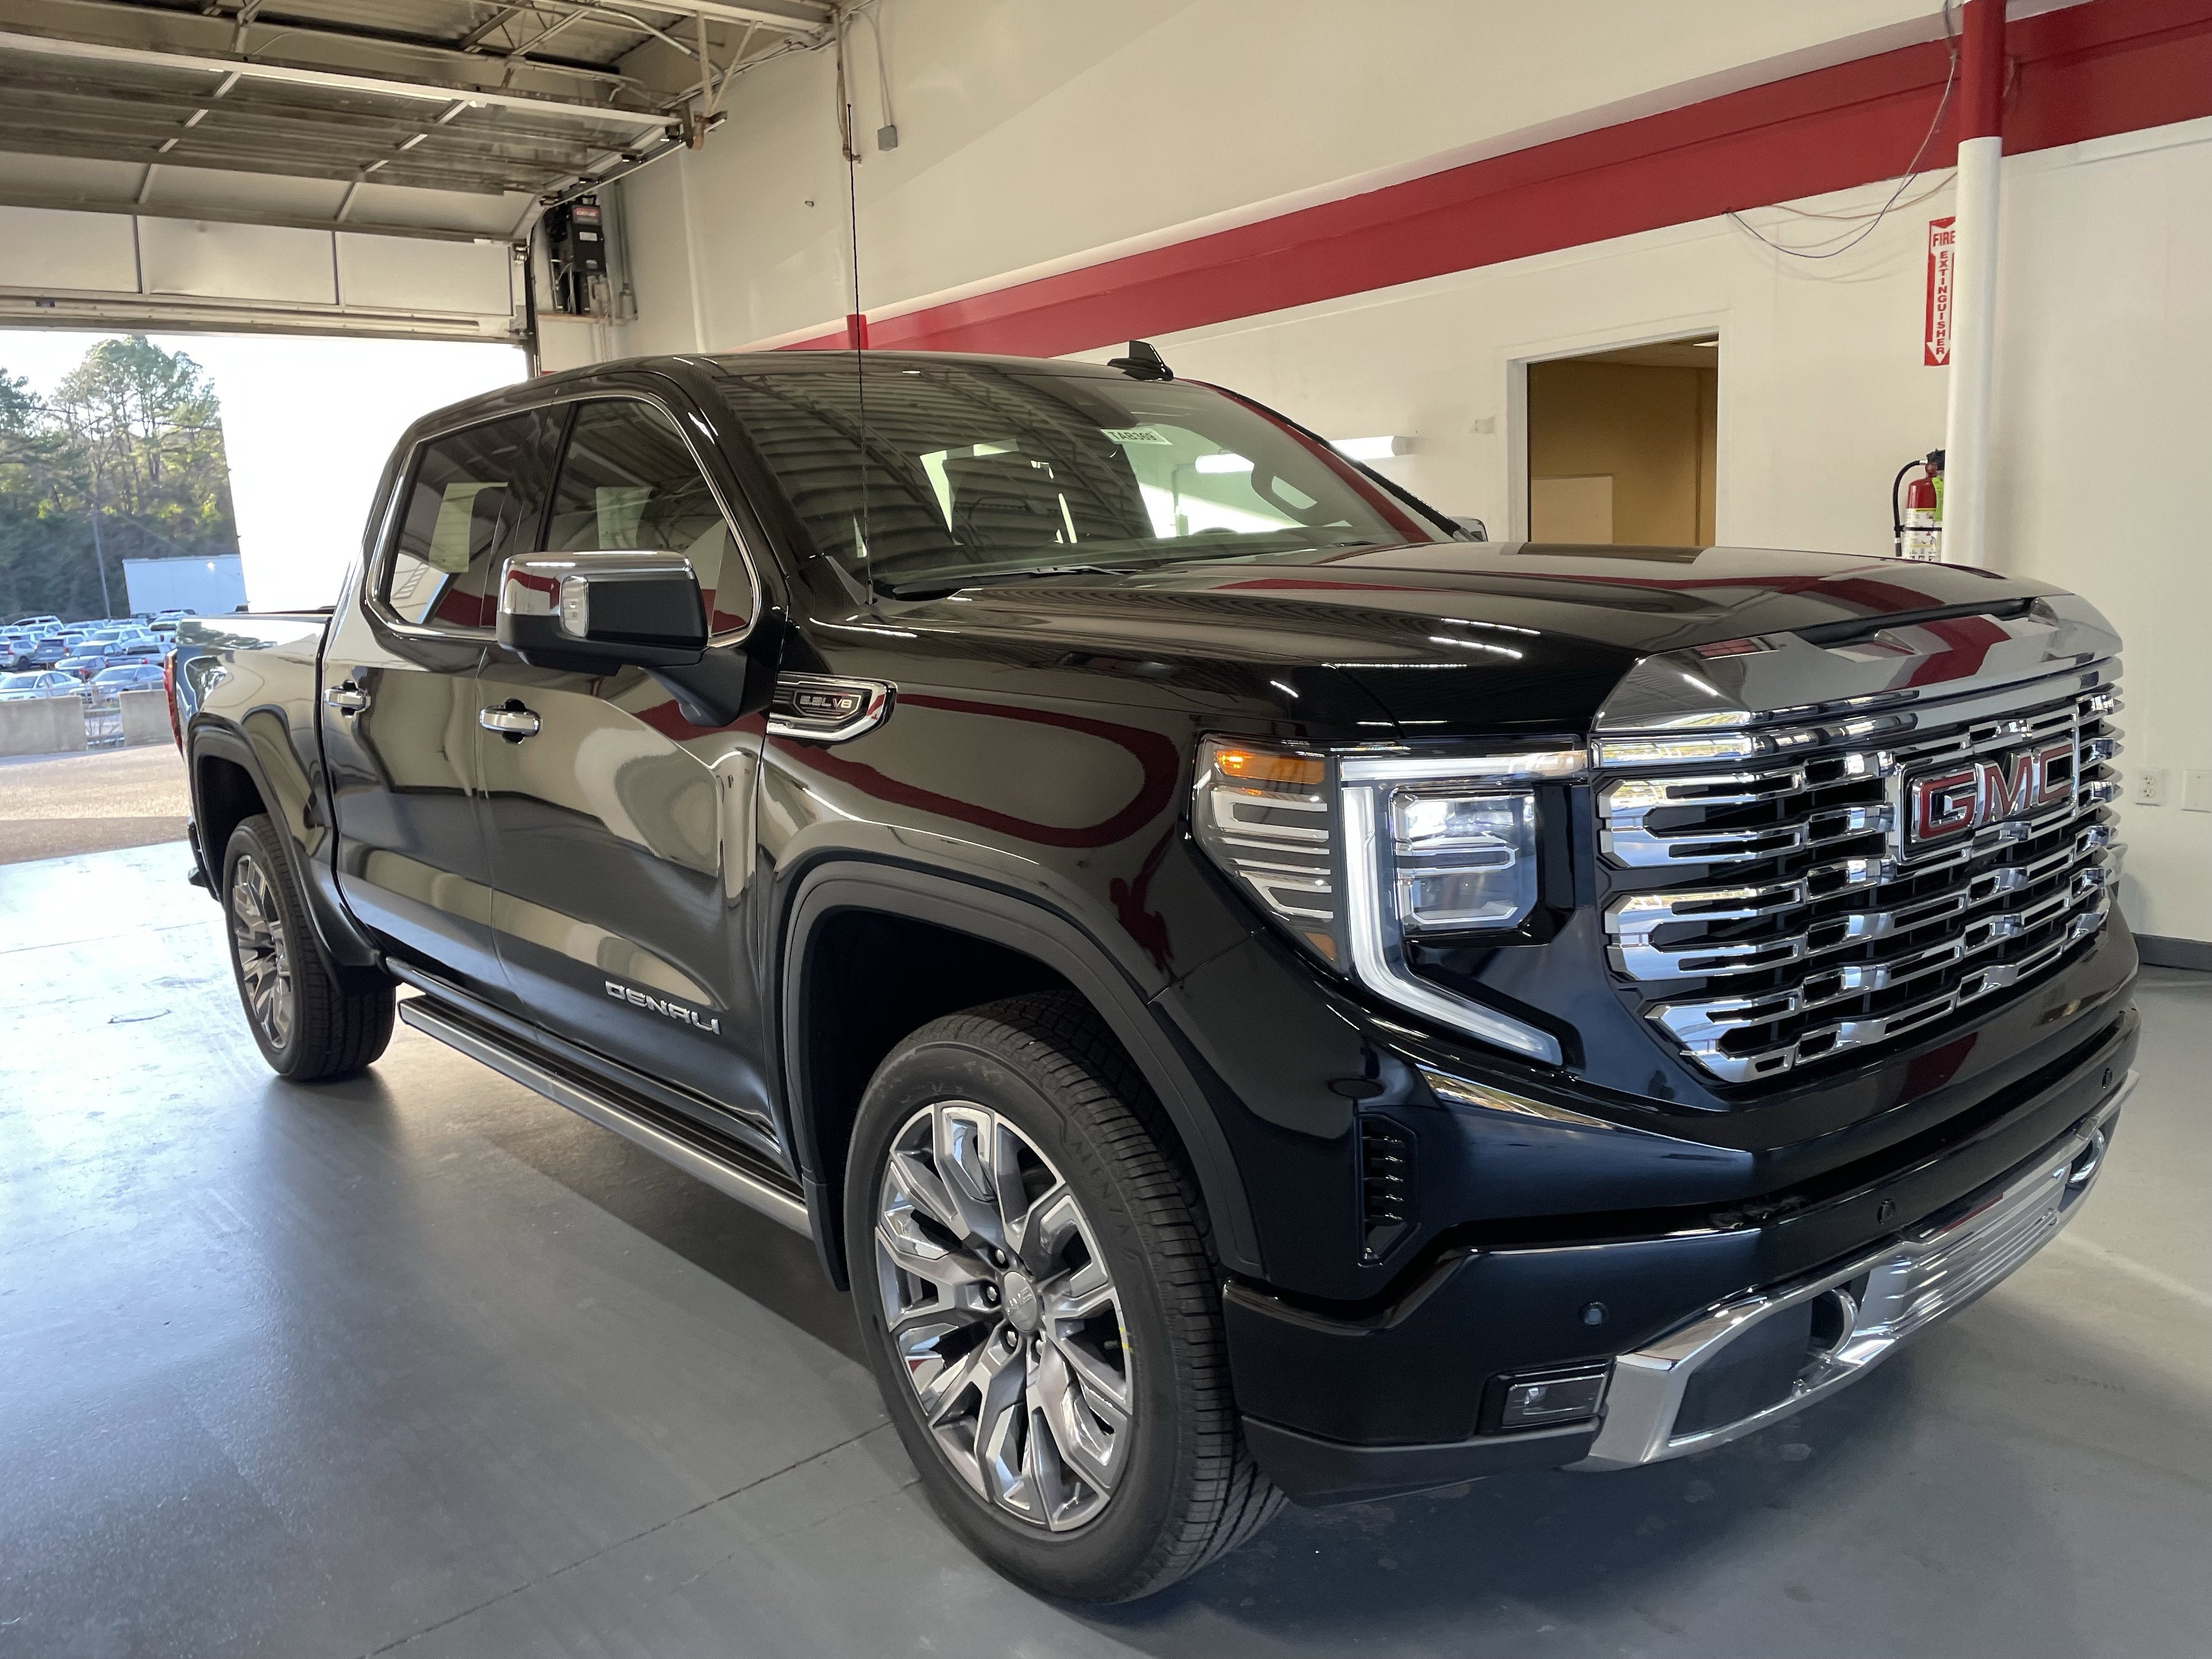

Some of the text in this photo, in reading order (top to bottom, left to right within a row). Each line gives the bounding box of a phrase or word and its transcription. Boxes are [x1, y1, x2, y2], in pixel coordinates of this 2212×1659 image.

[1933, 230, 1955, 247] FIRE
[1936, 251, 1948, 355] EXTINGUISHER
[1107, 431, 1157, 441] TAB369
[832, 698, 853, 709] V8
[1911, 741, 2074, 844] GMC
[605, 980, 720, 1035] DENALI
